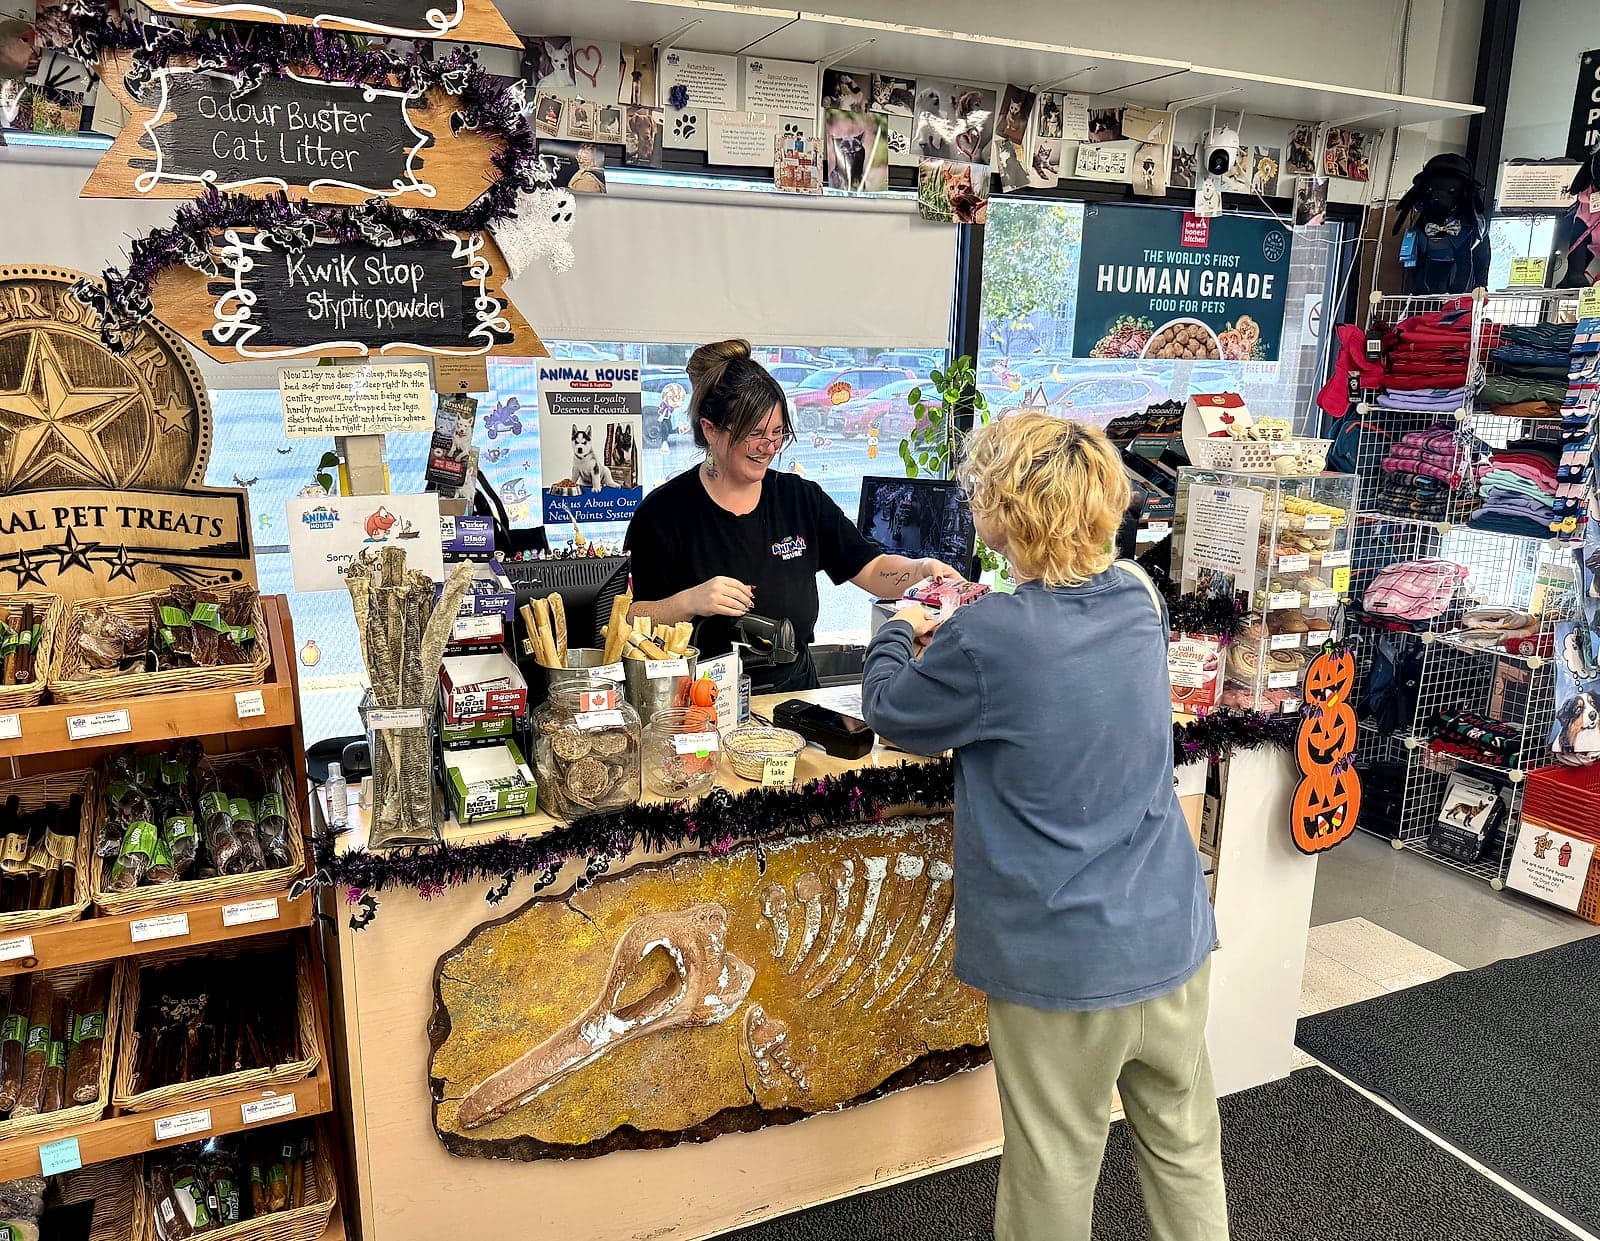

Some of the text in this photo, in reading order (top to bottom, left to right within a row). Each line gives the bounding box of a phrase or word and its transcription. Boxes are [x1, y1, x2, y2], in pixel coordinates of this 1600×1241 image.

[198, 96, 372, 134] Odour Buster
[212, 130, 360, 171] Cat Litter
[1143, 249, 1241, 268] THE WORLD'S FIRST
[364, 253, 425, 294] Stop
[1097, 264, 1275, 300] HUMAN GRADE
[1149, 299, 1226, 314] FOOD FOR PETS
[284, 370, 300, 379] Now
[302, 369, 310, 379] I
[540, 367, 639, 382] ANIMAL HOUSE
[284, 382, 299, 390] bed
[302, 382, 320, 392] soft
[411, 380, 425, 388] the
[286, 393, 313, 402] centre
[381, 391, 401, 402] being
[555, 393, 626, 405] Because Loyalty
[286, 404, 311, 416] hardly
[389, 402, 401, 411] her
[552, 404, 630, 414] Deserves Rewards
[403, 413, 426, 422] where
[297, 425, 322, 434] spend
[549, 499, 568, 510] Ask
[584, 498, 613, 508] About
[616, 498, 637, 507] Our
[52, 506, 108, 529] PET
[116, 506, 223, 537] TREATS
[302, 511, 340, 524] ANIMAL
[574, 510, 603, 521] Points
[310, 522, 334, 530] HOUSE
[460, 521, 488, 530] Turkey
[771, 541, 806, 555] ANIMAL
[782, 551, 803, 561] HOUSE
[455, 699, 484, 707] Meat
[765, 758, 788, 767] Please
[771, 768, 785, 776] take
[466, 792, 529, 809] Meat Beef
[466, 806, 496, 814] Bars
